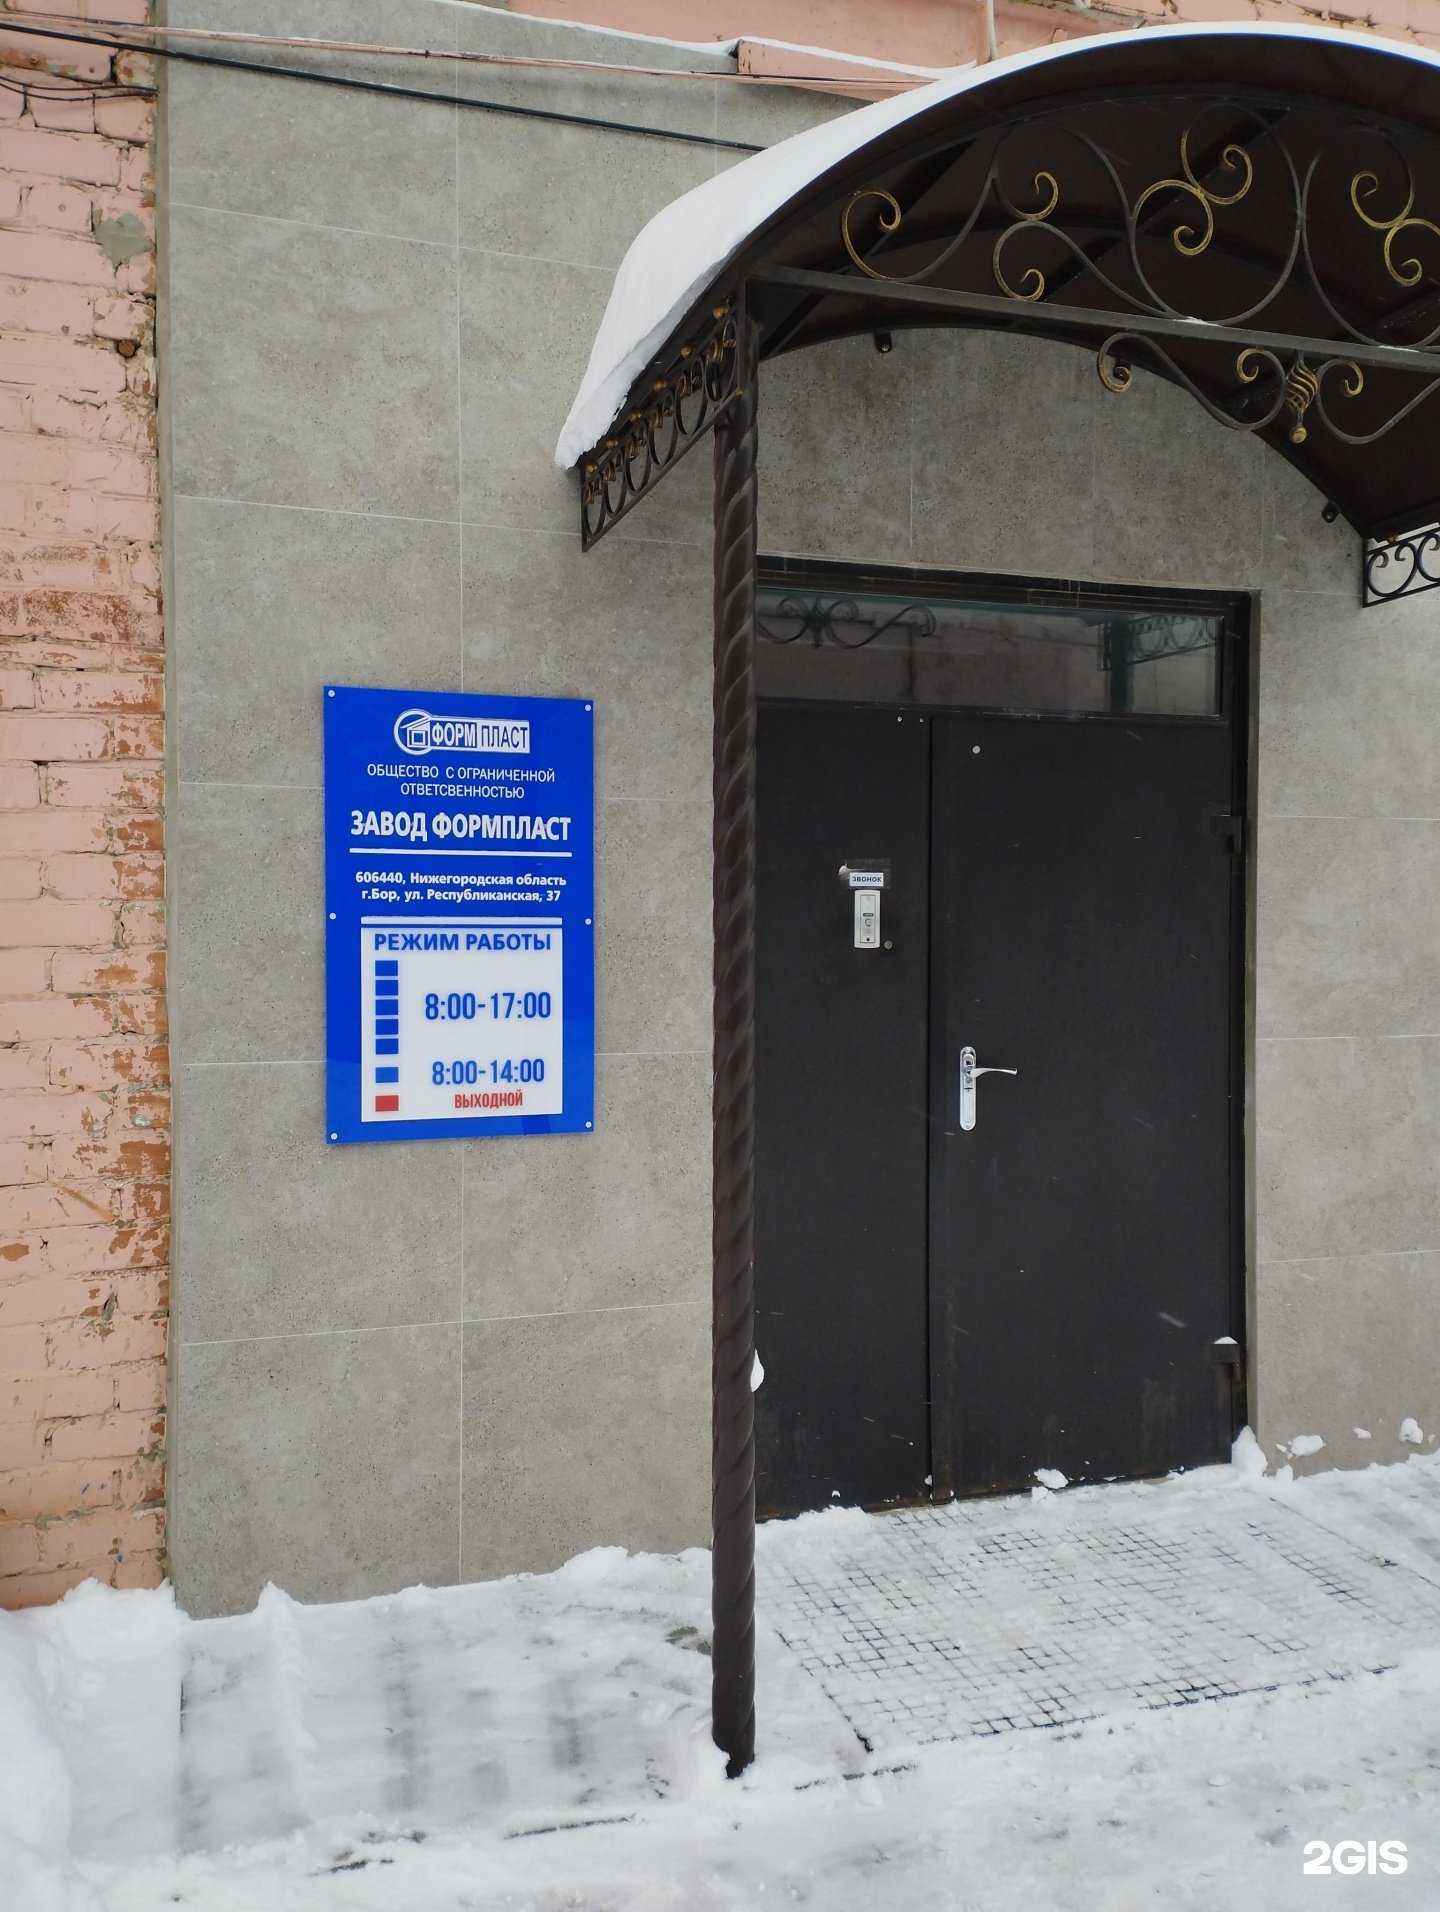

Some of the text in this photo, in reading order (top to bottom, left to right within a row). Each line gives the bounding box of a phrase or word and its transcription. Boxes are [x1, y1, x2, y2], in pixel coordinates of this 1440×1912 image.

[432, 722, 528, 749] ФОРМ ПЛАСТ
[367, 764, 555, 782] ОБЩЕСТВО С ОГРАНИЧЕННОЙ
[400, 783, 525, 799] ОТВЕТСВЕННОСТЬЮ
[351, 810, 571, 841] ЗАВОД ФОРМПЛАСТ
[355, 871, 567, 887] 606440, Нижегородская область
[361, 889, 561, 903] г.Бор, ул. Республиканская, 37
[374, 933, 551, 951] РЕЖИМ РАБОТЫ
[425, 992, 551, 1020] 8:00-17:00
[432, 1059, 545, 1085] 8:00-14:00
[454, 1089, 523, 1109] ВЫХОДНОЙ
